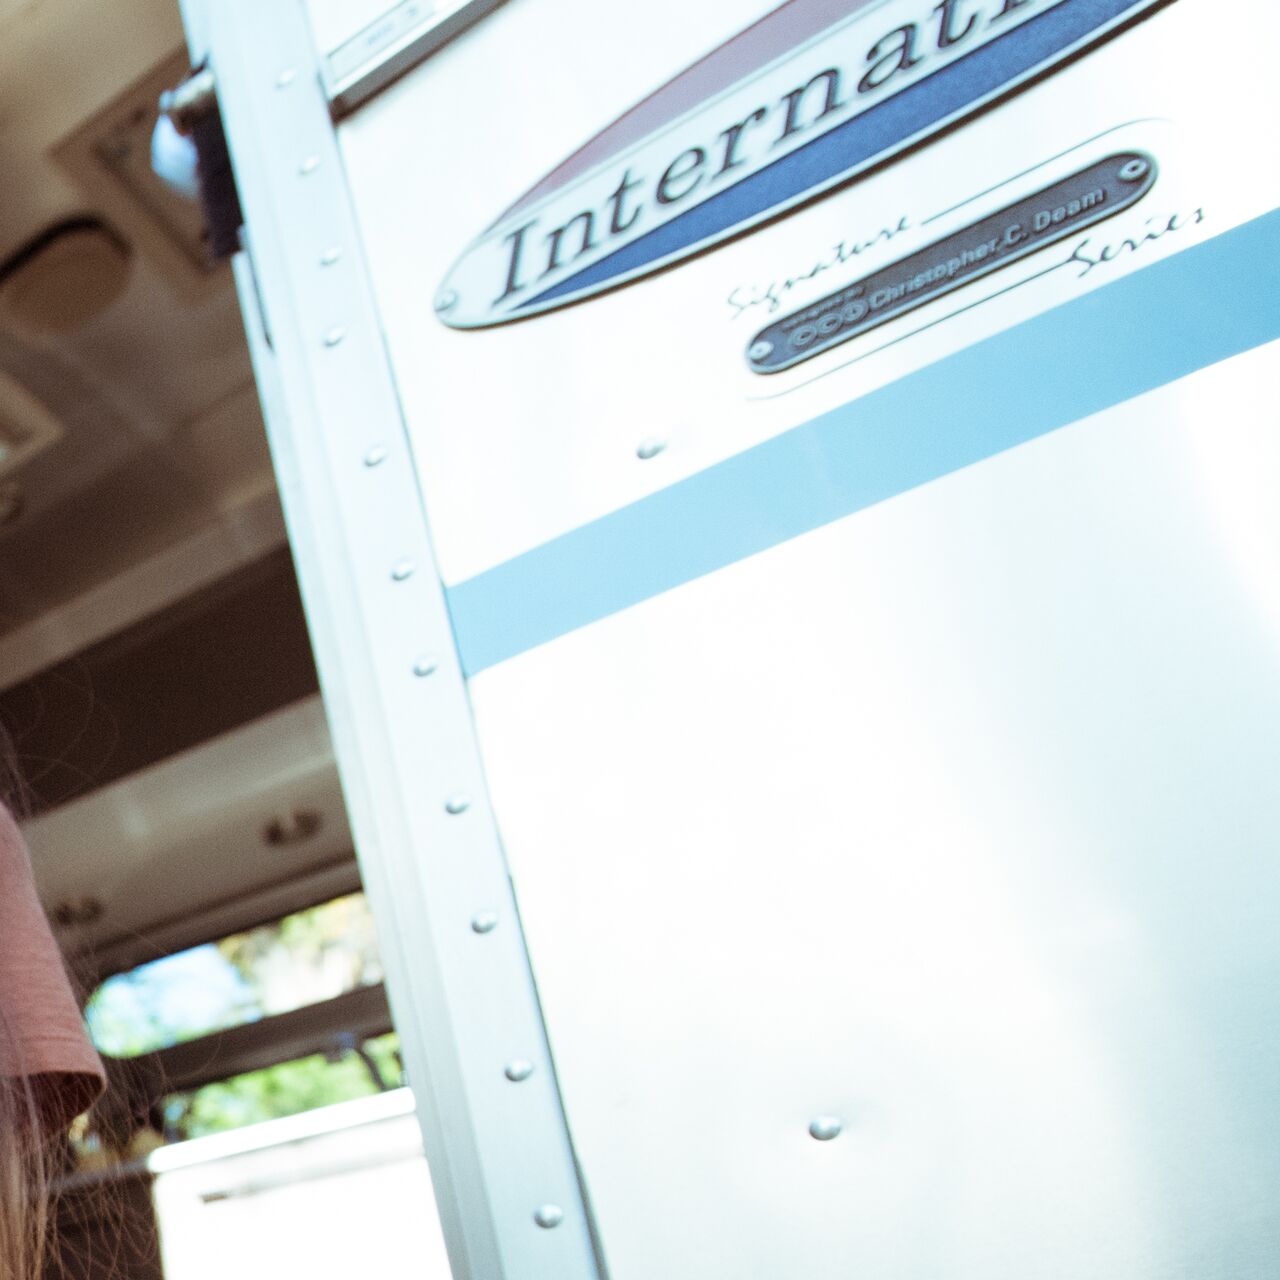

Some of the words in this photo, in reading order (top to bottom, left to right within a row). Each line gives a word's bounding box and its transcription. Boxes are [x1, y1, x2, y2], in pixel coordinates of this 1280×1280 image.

[727, 216, 913, 319] Signature
[868, 242, 999, 310] Christopher
[1033, 188, 1108, 231] Deam
[1067, 206, 1206, 279] Series
